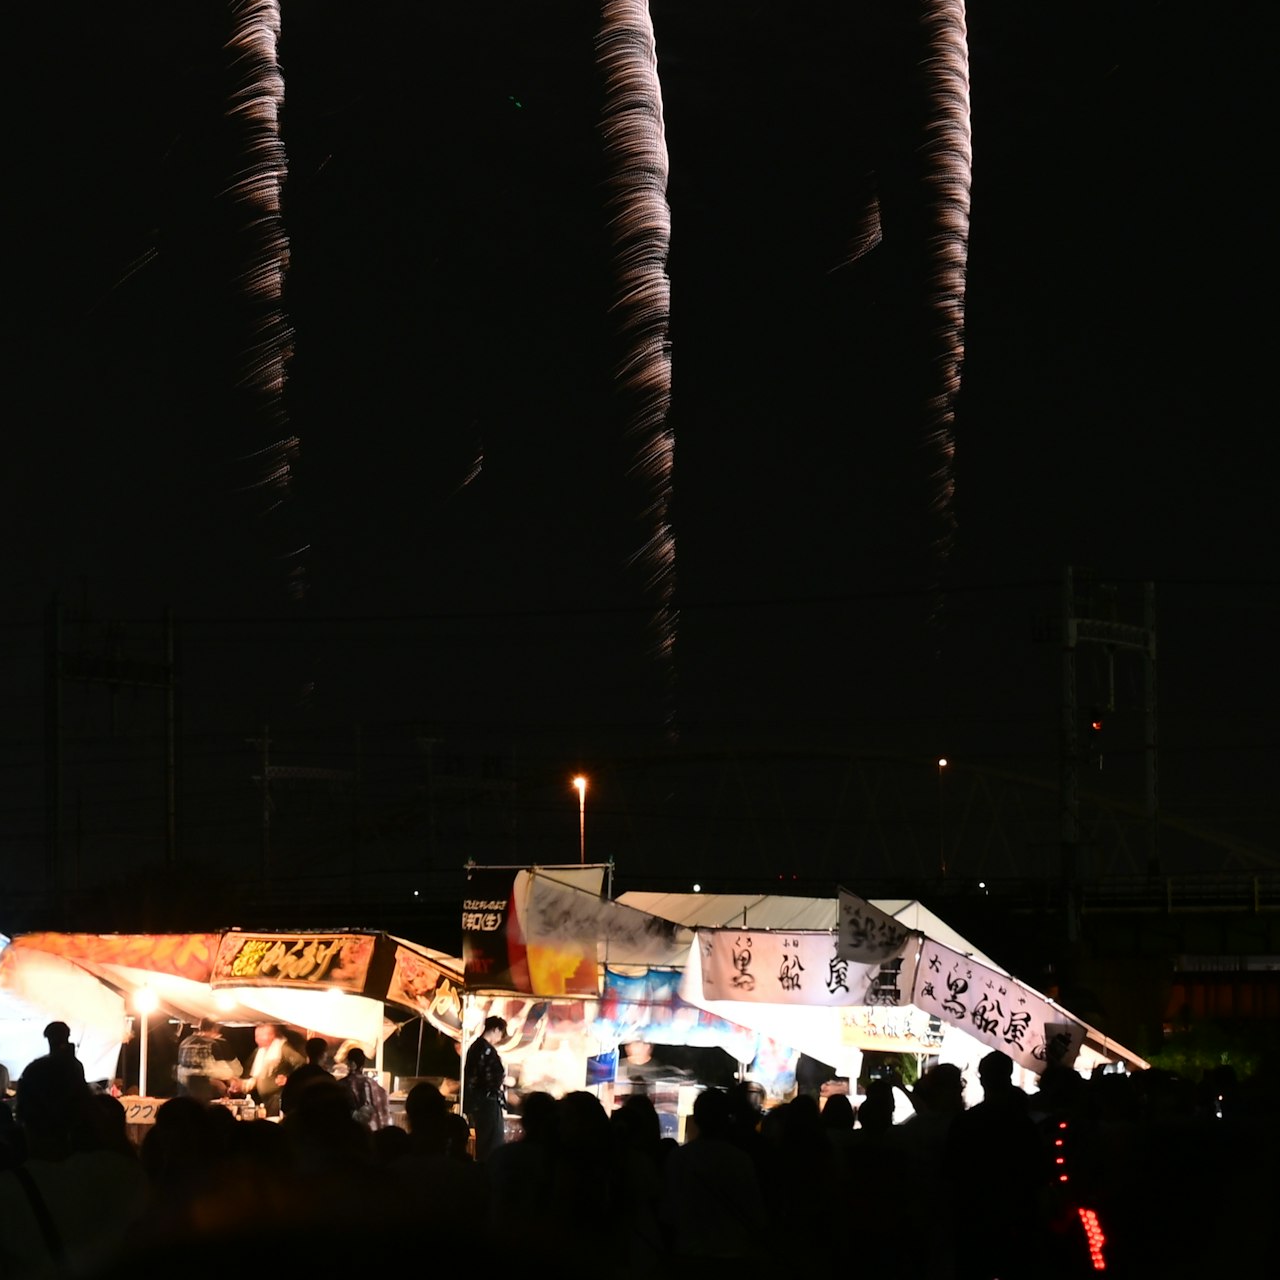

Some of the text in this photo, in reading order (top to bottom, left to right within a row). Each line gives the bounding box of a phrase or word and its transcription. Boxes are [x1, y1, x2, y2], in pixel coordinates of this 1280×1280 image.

[731, 948, 851, 995] 黒船屋
[429, 978, 463, 1022] か
[941, 971, 1032, 1052] 黒船屋
